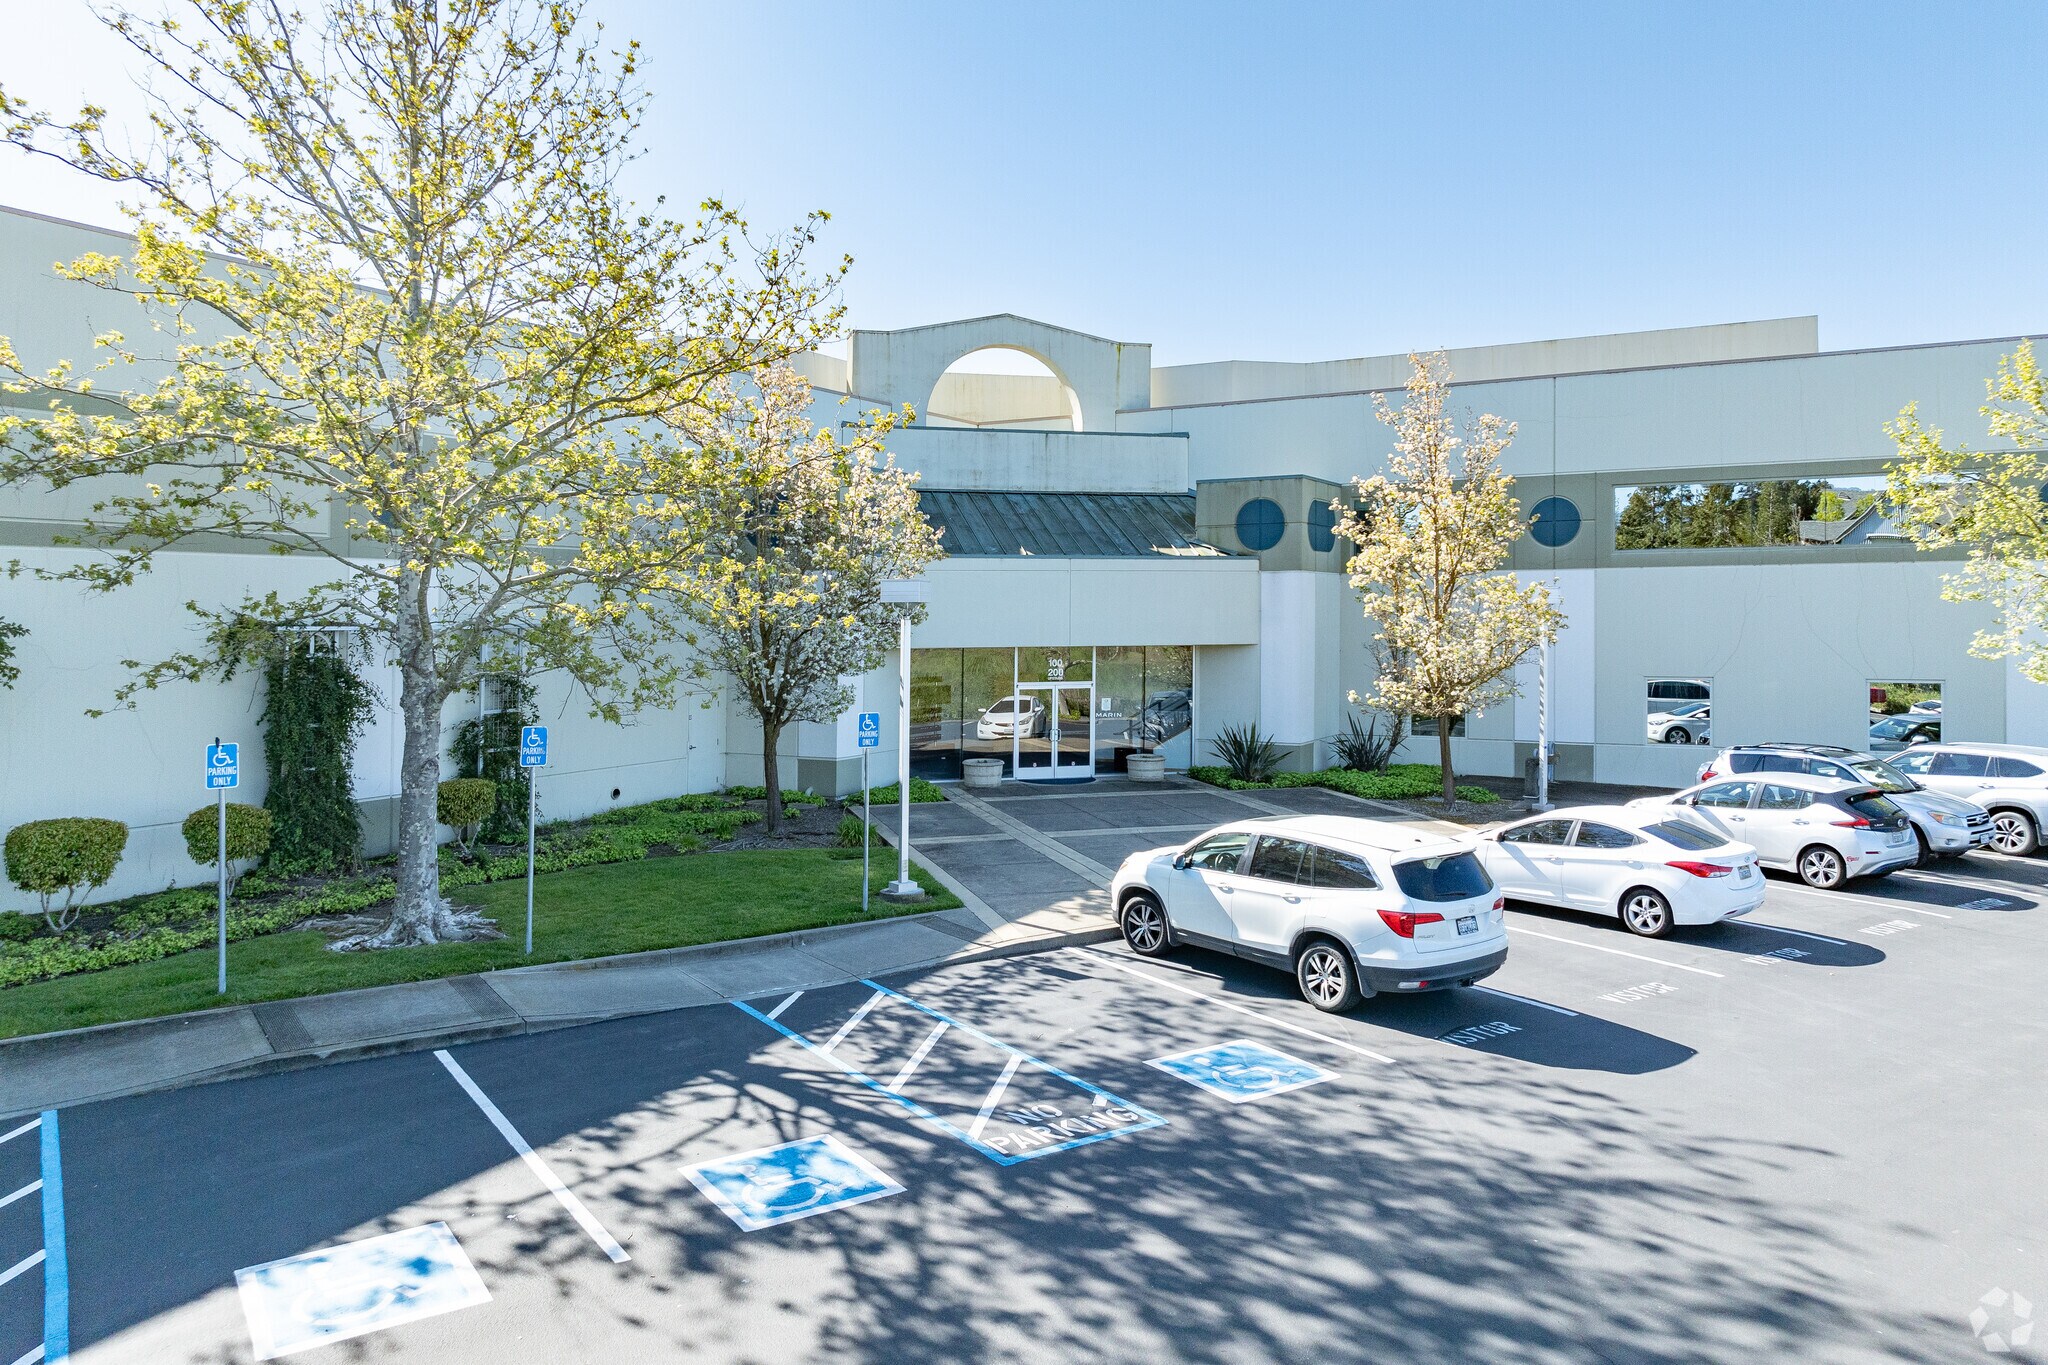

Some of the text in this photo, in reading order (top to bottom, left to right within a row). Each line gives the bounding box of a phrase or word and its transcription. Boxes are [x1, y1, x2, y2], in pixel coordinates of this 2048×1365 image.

[1048, 658, 1063, 668] 100
[1048, 668, 1064, 677] 200
[522, 747, 546, 755] PARKING
[526, 755, 542, 764] ONLY
[208, 766, 237, 776] PARKING
[213, 776, 232, 786] ONLY
[1857, 919, 1922, 936] VISITOR
[1740, 947, 1812, 966] VISITOR
[1597, 982, 1679, 1004] VISITOR
[1005, 1104, 1063, 1125] NO
[982, 1107, 1139, 1154] PARKING
